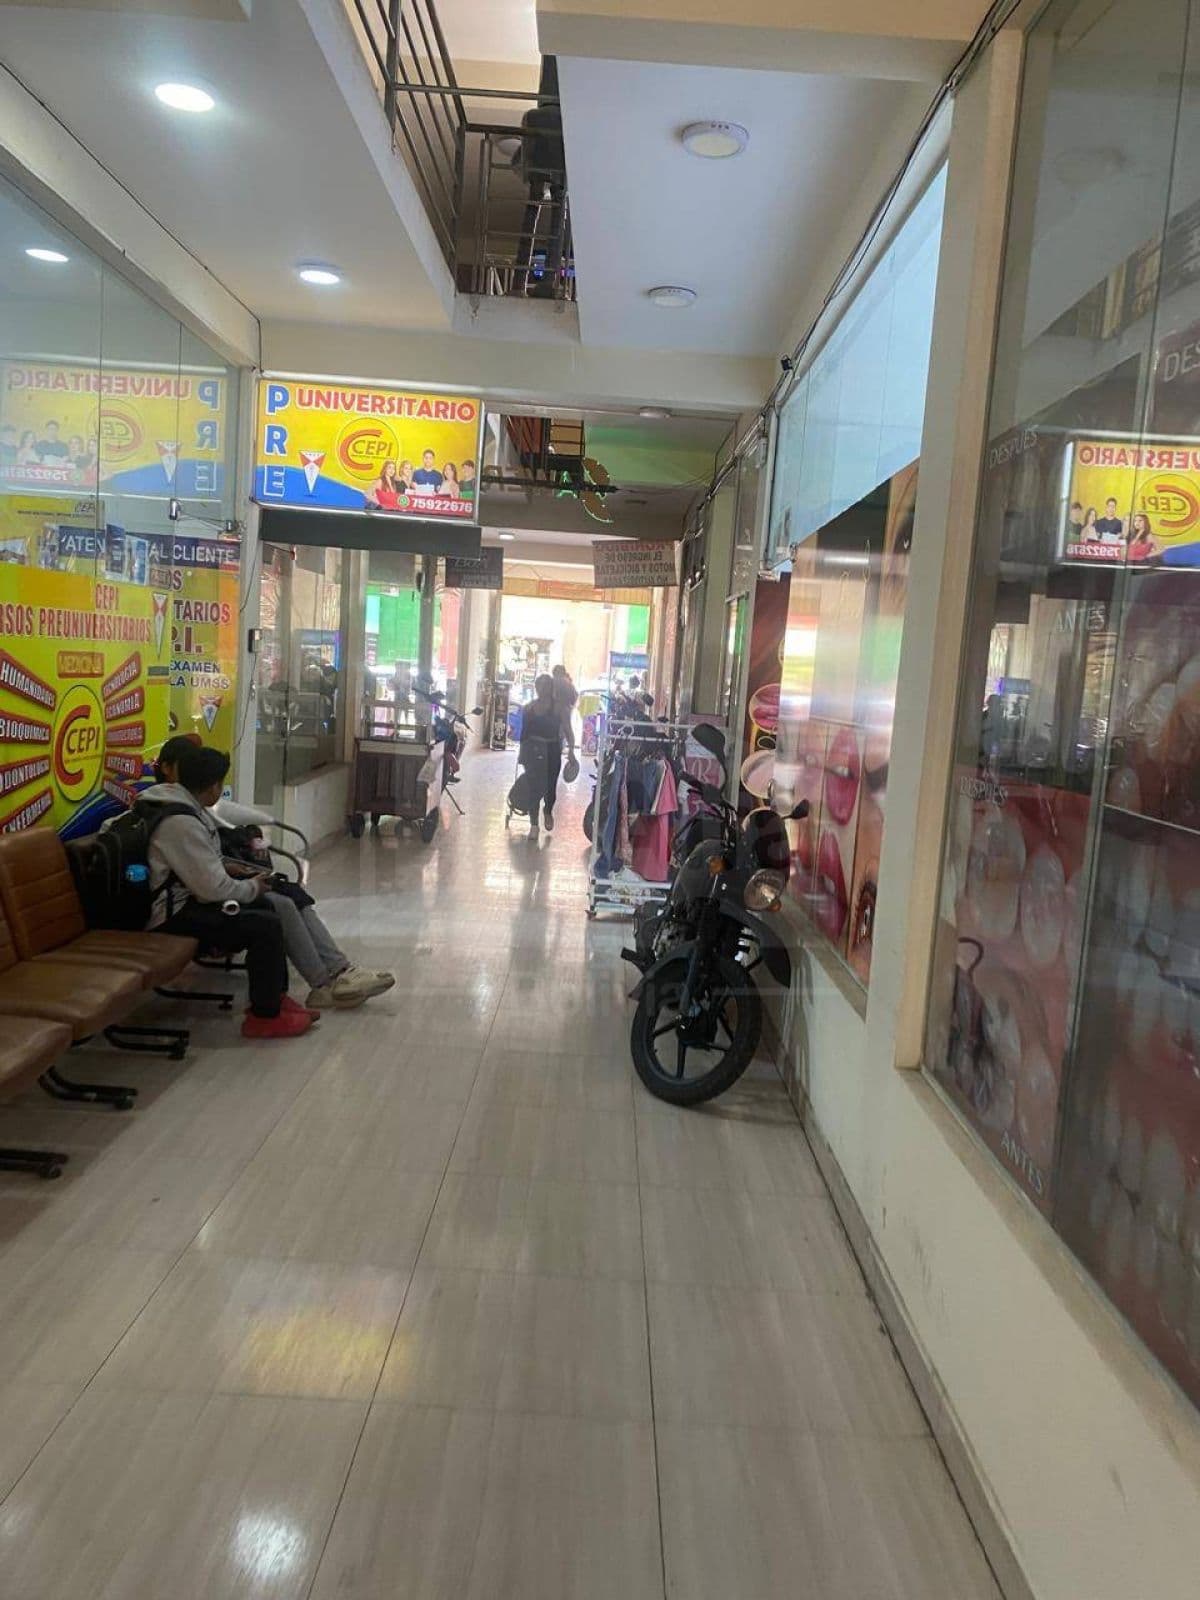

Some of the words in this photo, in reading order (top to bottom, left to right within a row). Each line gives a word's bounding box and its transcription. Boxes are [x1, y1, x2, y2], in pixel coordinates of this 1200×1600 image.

[295, 387, 477, 423] UNIVERSITARIO
[351, 439, 393, 458] CEPI
[412, 497, 473, 513] 75922676
[172, 544, 235, 564] CLIENTE
[95, 583, 119, 611] CEPI
[39, 607, 151, 642] PREUNIVERSITARIOS
[190, 676, 230, 690] UMSS
[66, 726, 101, 755] CEPI
